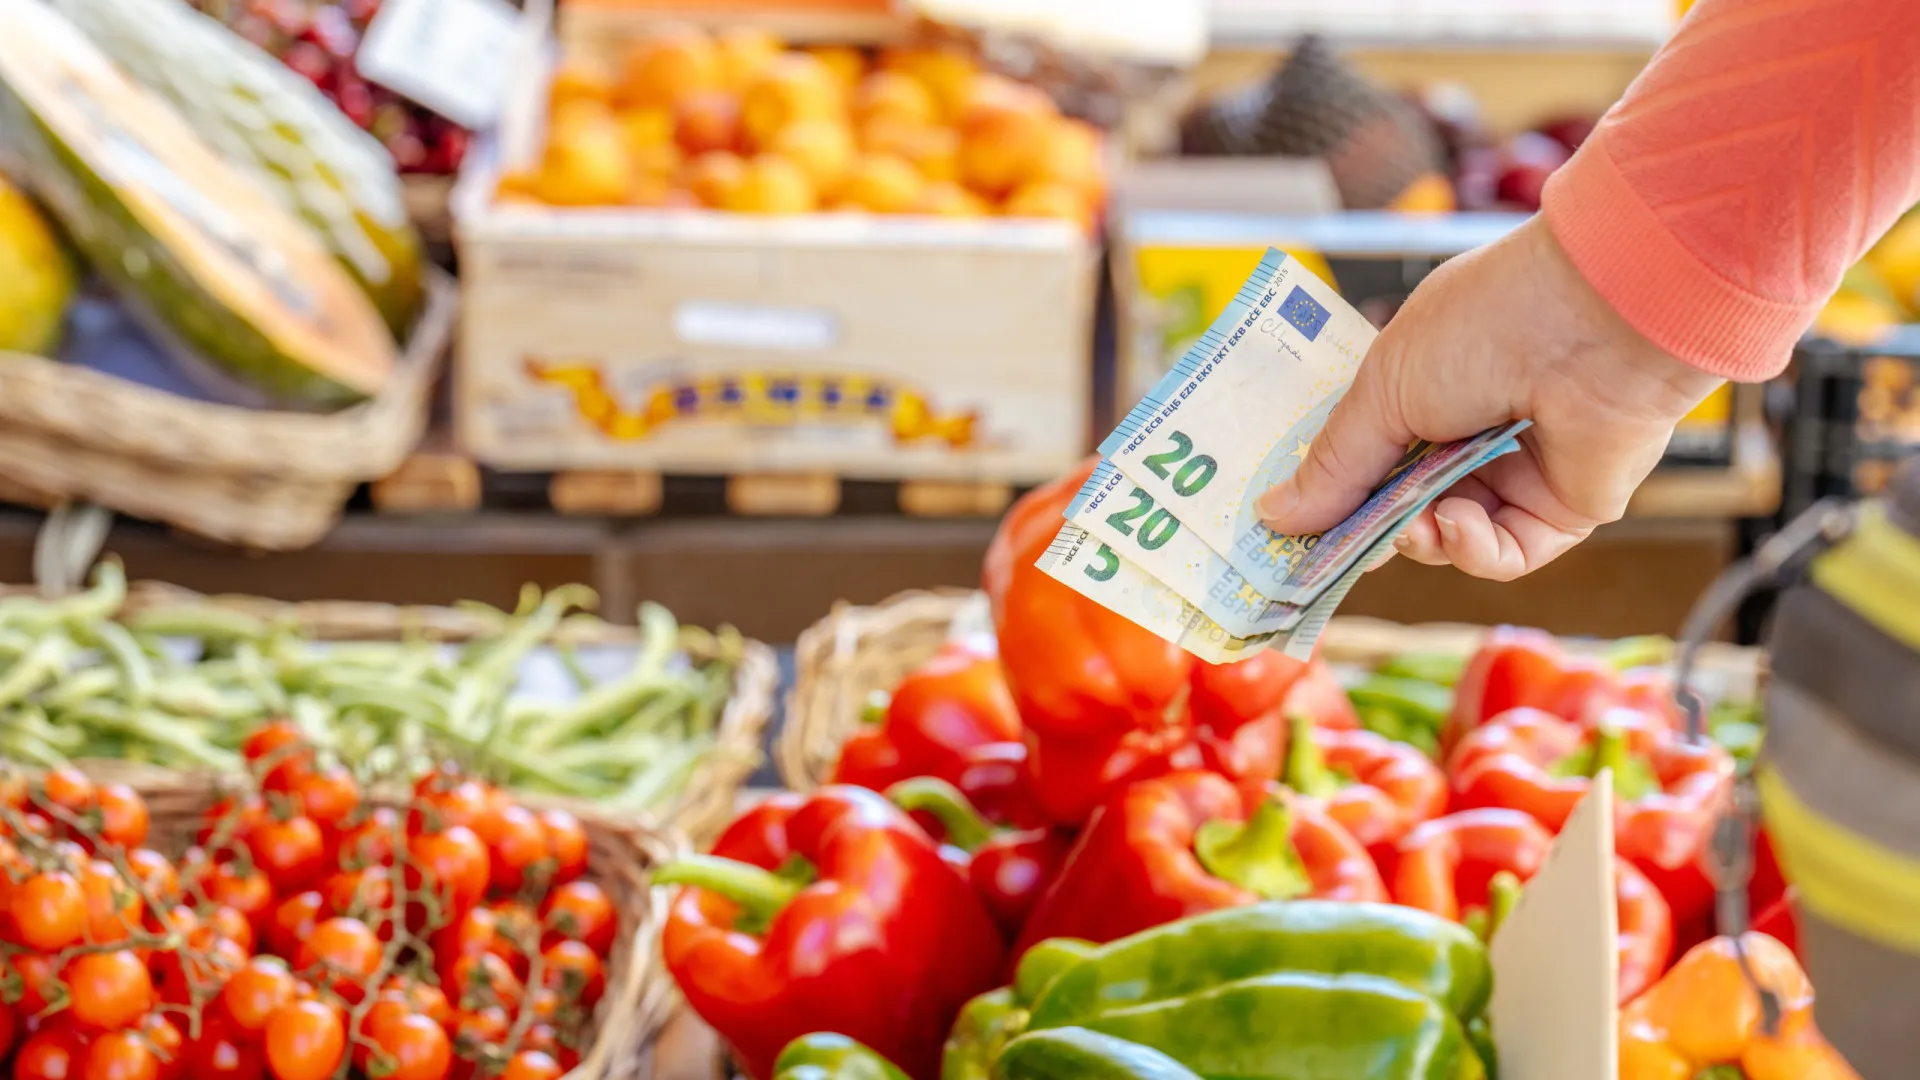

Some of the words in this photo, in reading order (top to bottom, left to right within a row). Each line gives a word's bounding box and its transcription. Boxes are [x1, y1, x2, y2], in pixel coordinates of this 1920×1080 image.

[1145, 416, 1163, 436] ECB
[1179, 381, 1198, 400] EZB
[1195, 363, 1213, 383] EKP
[1228, 326, 1246, 347] EKB
[1259, 288, 1277, 308] EBC
[1274, 268, 1289, 287] 2015
[1105, 472, 1123, 492] ECB
[1142, 431, 1218, 497] 20
[1105, 487, 1181, 551] 20
